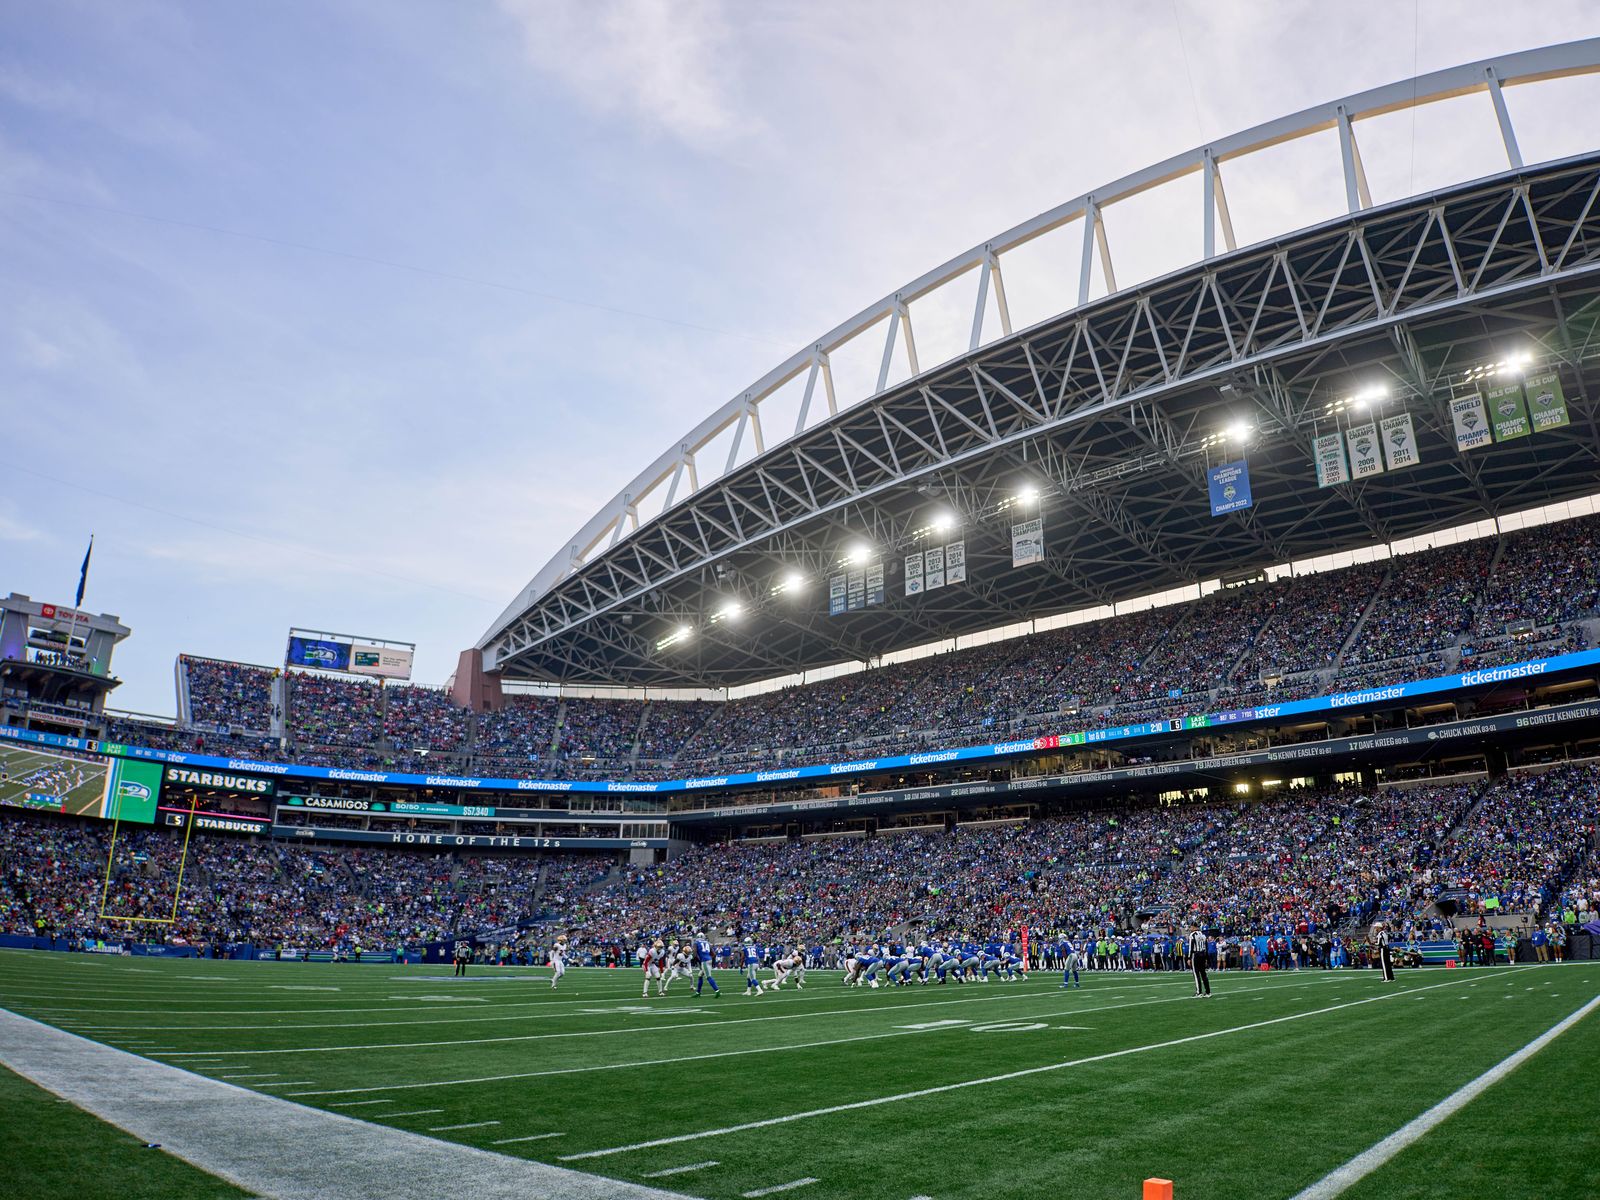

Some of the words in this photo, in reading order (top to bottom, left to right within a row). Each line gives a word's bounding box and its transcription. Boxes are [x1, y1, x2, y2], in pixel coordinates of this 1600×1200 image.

[1542, 375, 1557, 385] CUP
[1504, 385, 1519, 395] CUP
[1453, 400, 1481, 413] SHIELD
[1533, 407, 1565, 420] CHAMPS
[1383, 419, 1409, 431] CHAMPS
[1495, 417, 1527, 430] CHAMPS
[1540, 415, 1561, 427] 2019
[1349, 429, 1374, 440] CHAMPS
[1457, 428, 1489, 442] CHAMPS
[1502, 425, 1523, 437] 2016
[1465, 437, 1484, 447] 2014
[1393, 448, 1409, 458] 2011
[1394, 455, 1411, 464] 2014
[1213, 468, 1242, 481] CHAMPIONS
[1359, 465, 1376, 474] 2010
[58, 610, 89, 623] TOYOTA
[1461, 662, 1547, 687] ticketmaster
[1330, 686, 1405, 708] ticketmaster
[1190, 715, 1206, 723] LAST
[1516, 717, 1529, 727] 96
[1529, 713, 1556, 726] CORTEZ
[1557, 707, 1590, 721] KENNEDY
[1150, 722, 1163, 733] 2:10
[1439, 728, 1462, 739] CHUCK
[1463, 725, 1482, 736] KNOX
[1049, 737, 1054, 747] 3
[1349, 742, 1358, 751] 17
[1358, 740, 1374, 750] DAVE
[1374, 737, 1395, 748] KRIEG
[910, 751, 959, 765] ticketmaster
[1267, 752, 1278, 761] 45
[1278, 750, 1297, 760] KENNY
[1298, 747, 1319, 758] EASLEY
[228, 760, 288, 774] ticketmaster
[830, 761, 877, 774] ticketmaster
[1204, 759, 1221, 769] JACOB
[1221, 758, 1239, 767] GREEN
[328, 769, 387, 782] ticketmaster
[757, 770, 800, 782] ticketmaster
[1134, 769, 1147, 777] PAUL
[1153, 766, 1169, 774] ALLEN
[167, 768, 268, 792] STARBUCKS
[426, 776, 481, 787] ticketmaster
[685, 777, 728, 789] ticketmaster
[1081, 773, 1102, 783] WARNER
[518, 780, 572, 791] ticketmaster
[608, 782, 658, 792] ticketmaster
[305, 797, 369, 811] CASAMIGOS
[196, 818, 262, 832] STARBUCKS
[392, 834, 442, 844] HOME
[456, 836, 477, 845] OF
[488, 837, 520, 847] THE
[701, 942, 710, 953] 14
